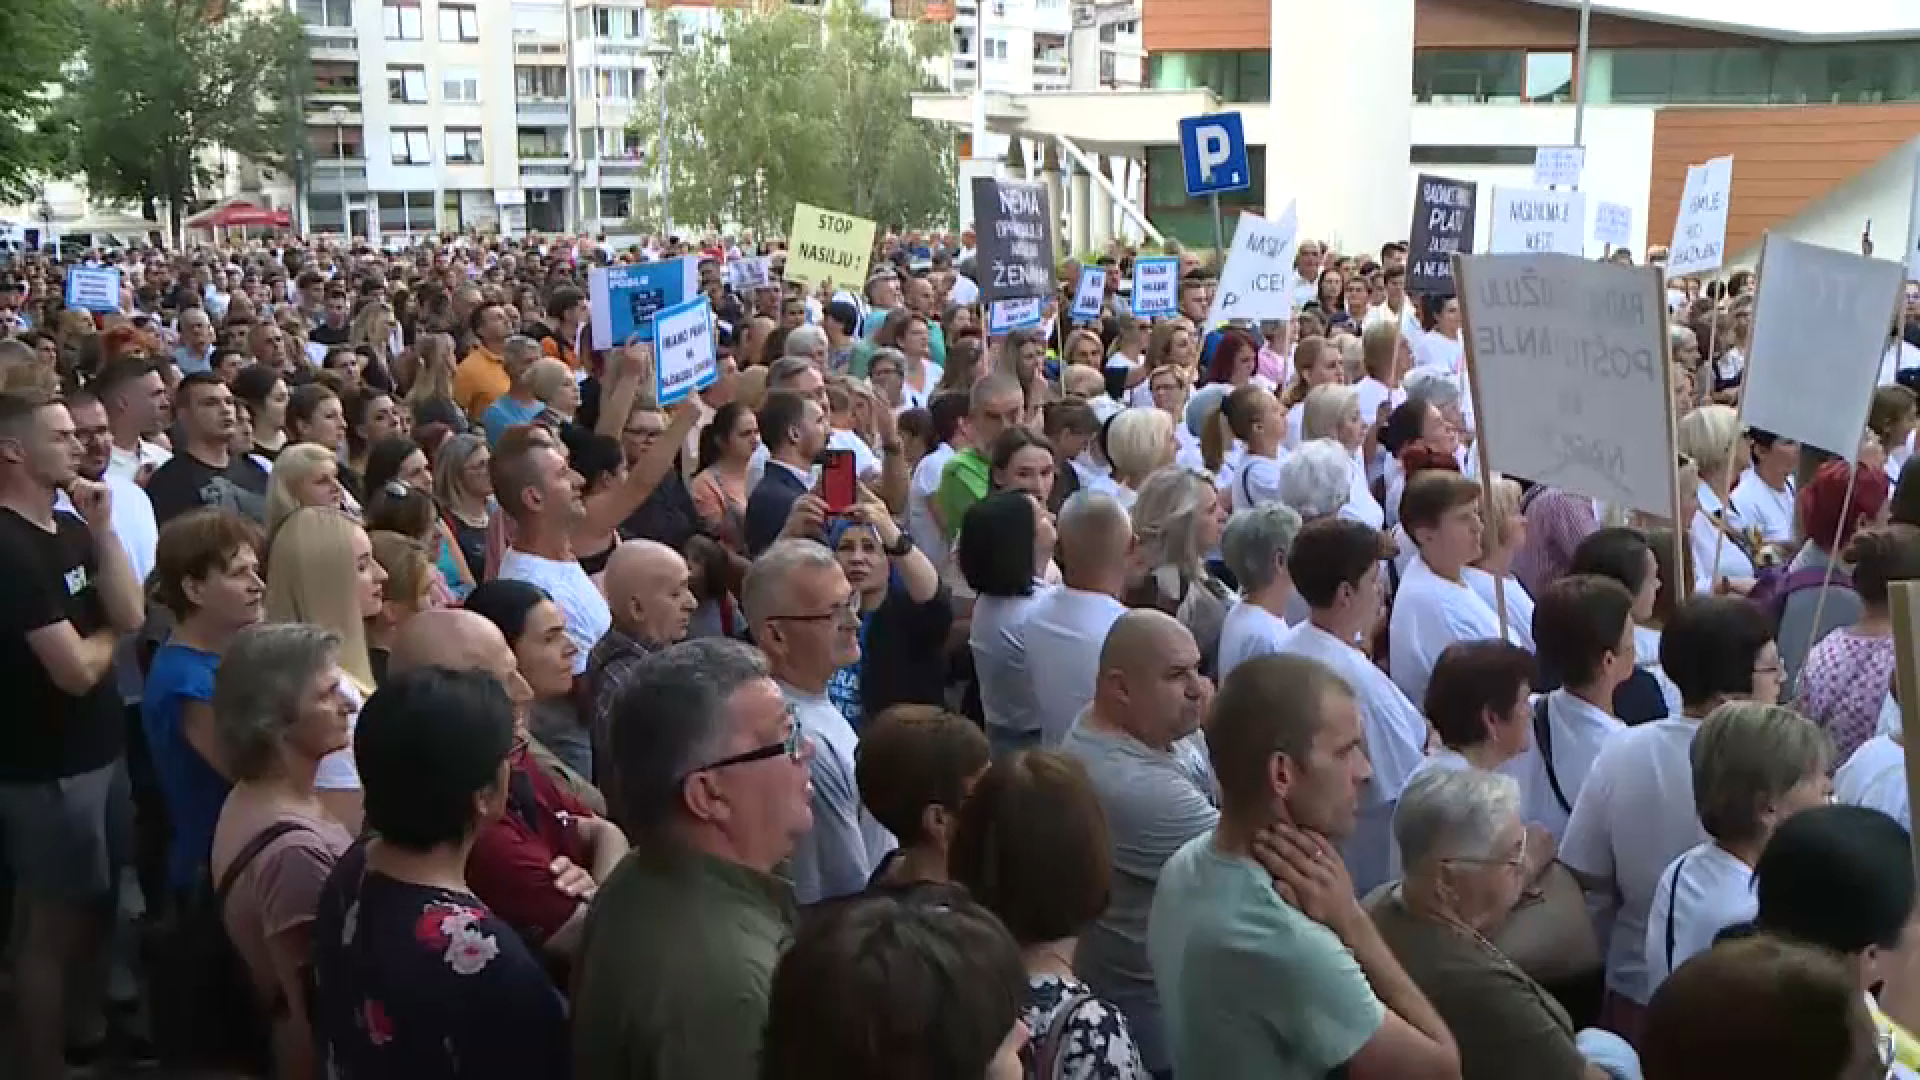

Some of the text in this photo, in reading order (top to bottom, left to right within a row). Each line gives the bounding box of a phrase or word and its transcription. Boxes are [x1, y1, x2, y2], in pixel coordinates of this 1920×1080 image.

[1195, 124, 1231, 184] P
[997, 188, 1041, 215] NEMA
[817, 213, 853, 234] STOP
